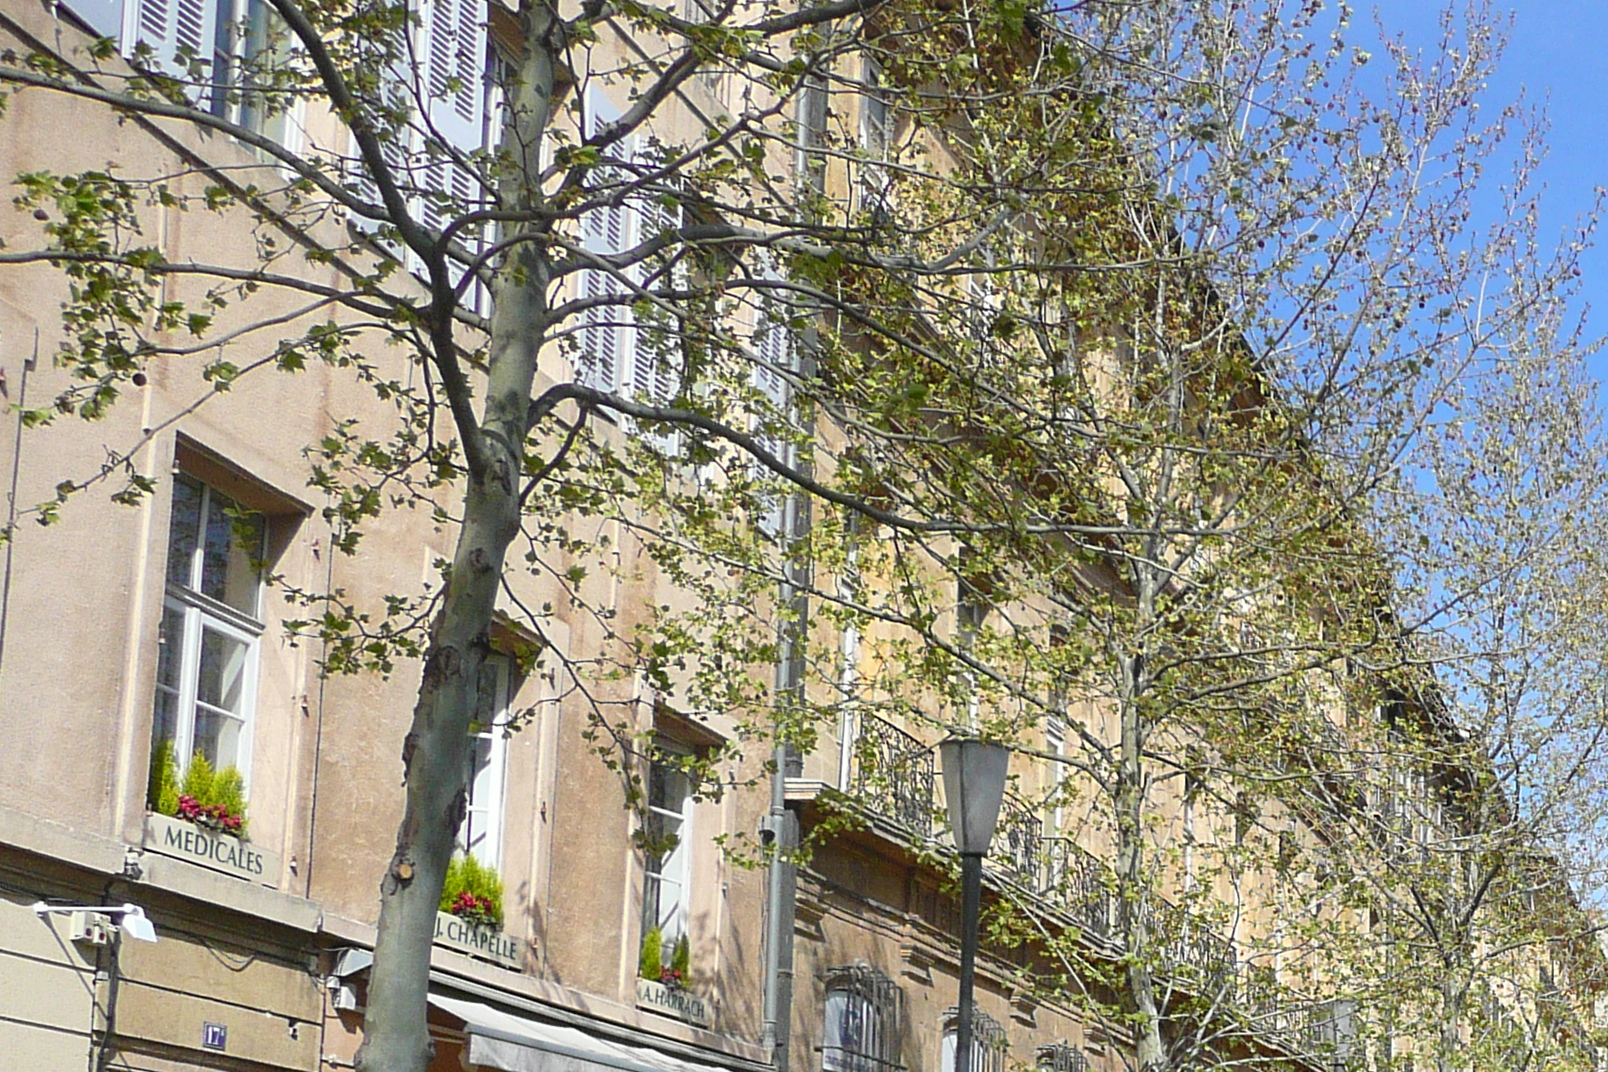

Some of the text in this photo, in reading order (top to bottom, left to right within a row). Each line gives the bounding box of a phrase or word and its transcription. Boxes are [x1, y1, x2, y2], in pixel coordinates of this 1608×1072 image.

[164, 825, 263, 875] MEDICALES
[434, 918, 517, 961] J. CHAPELLE
